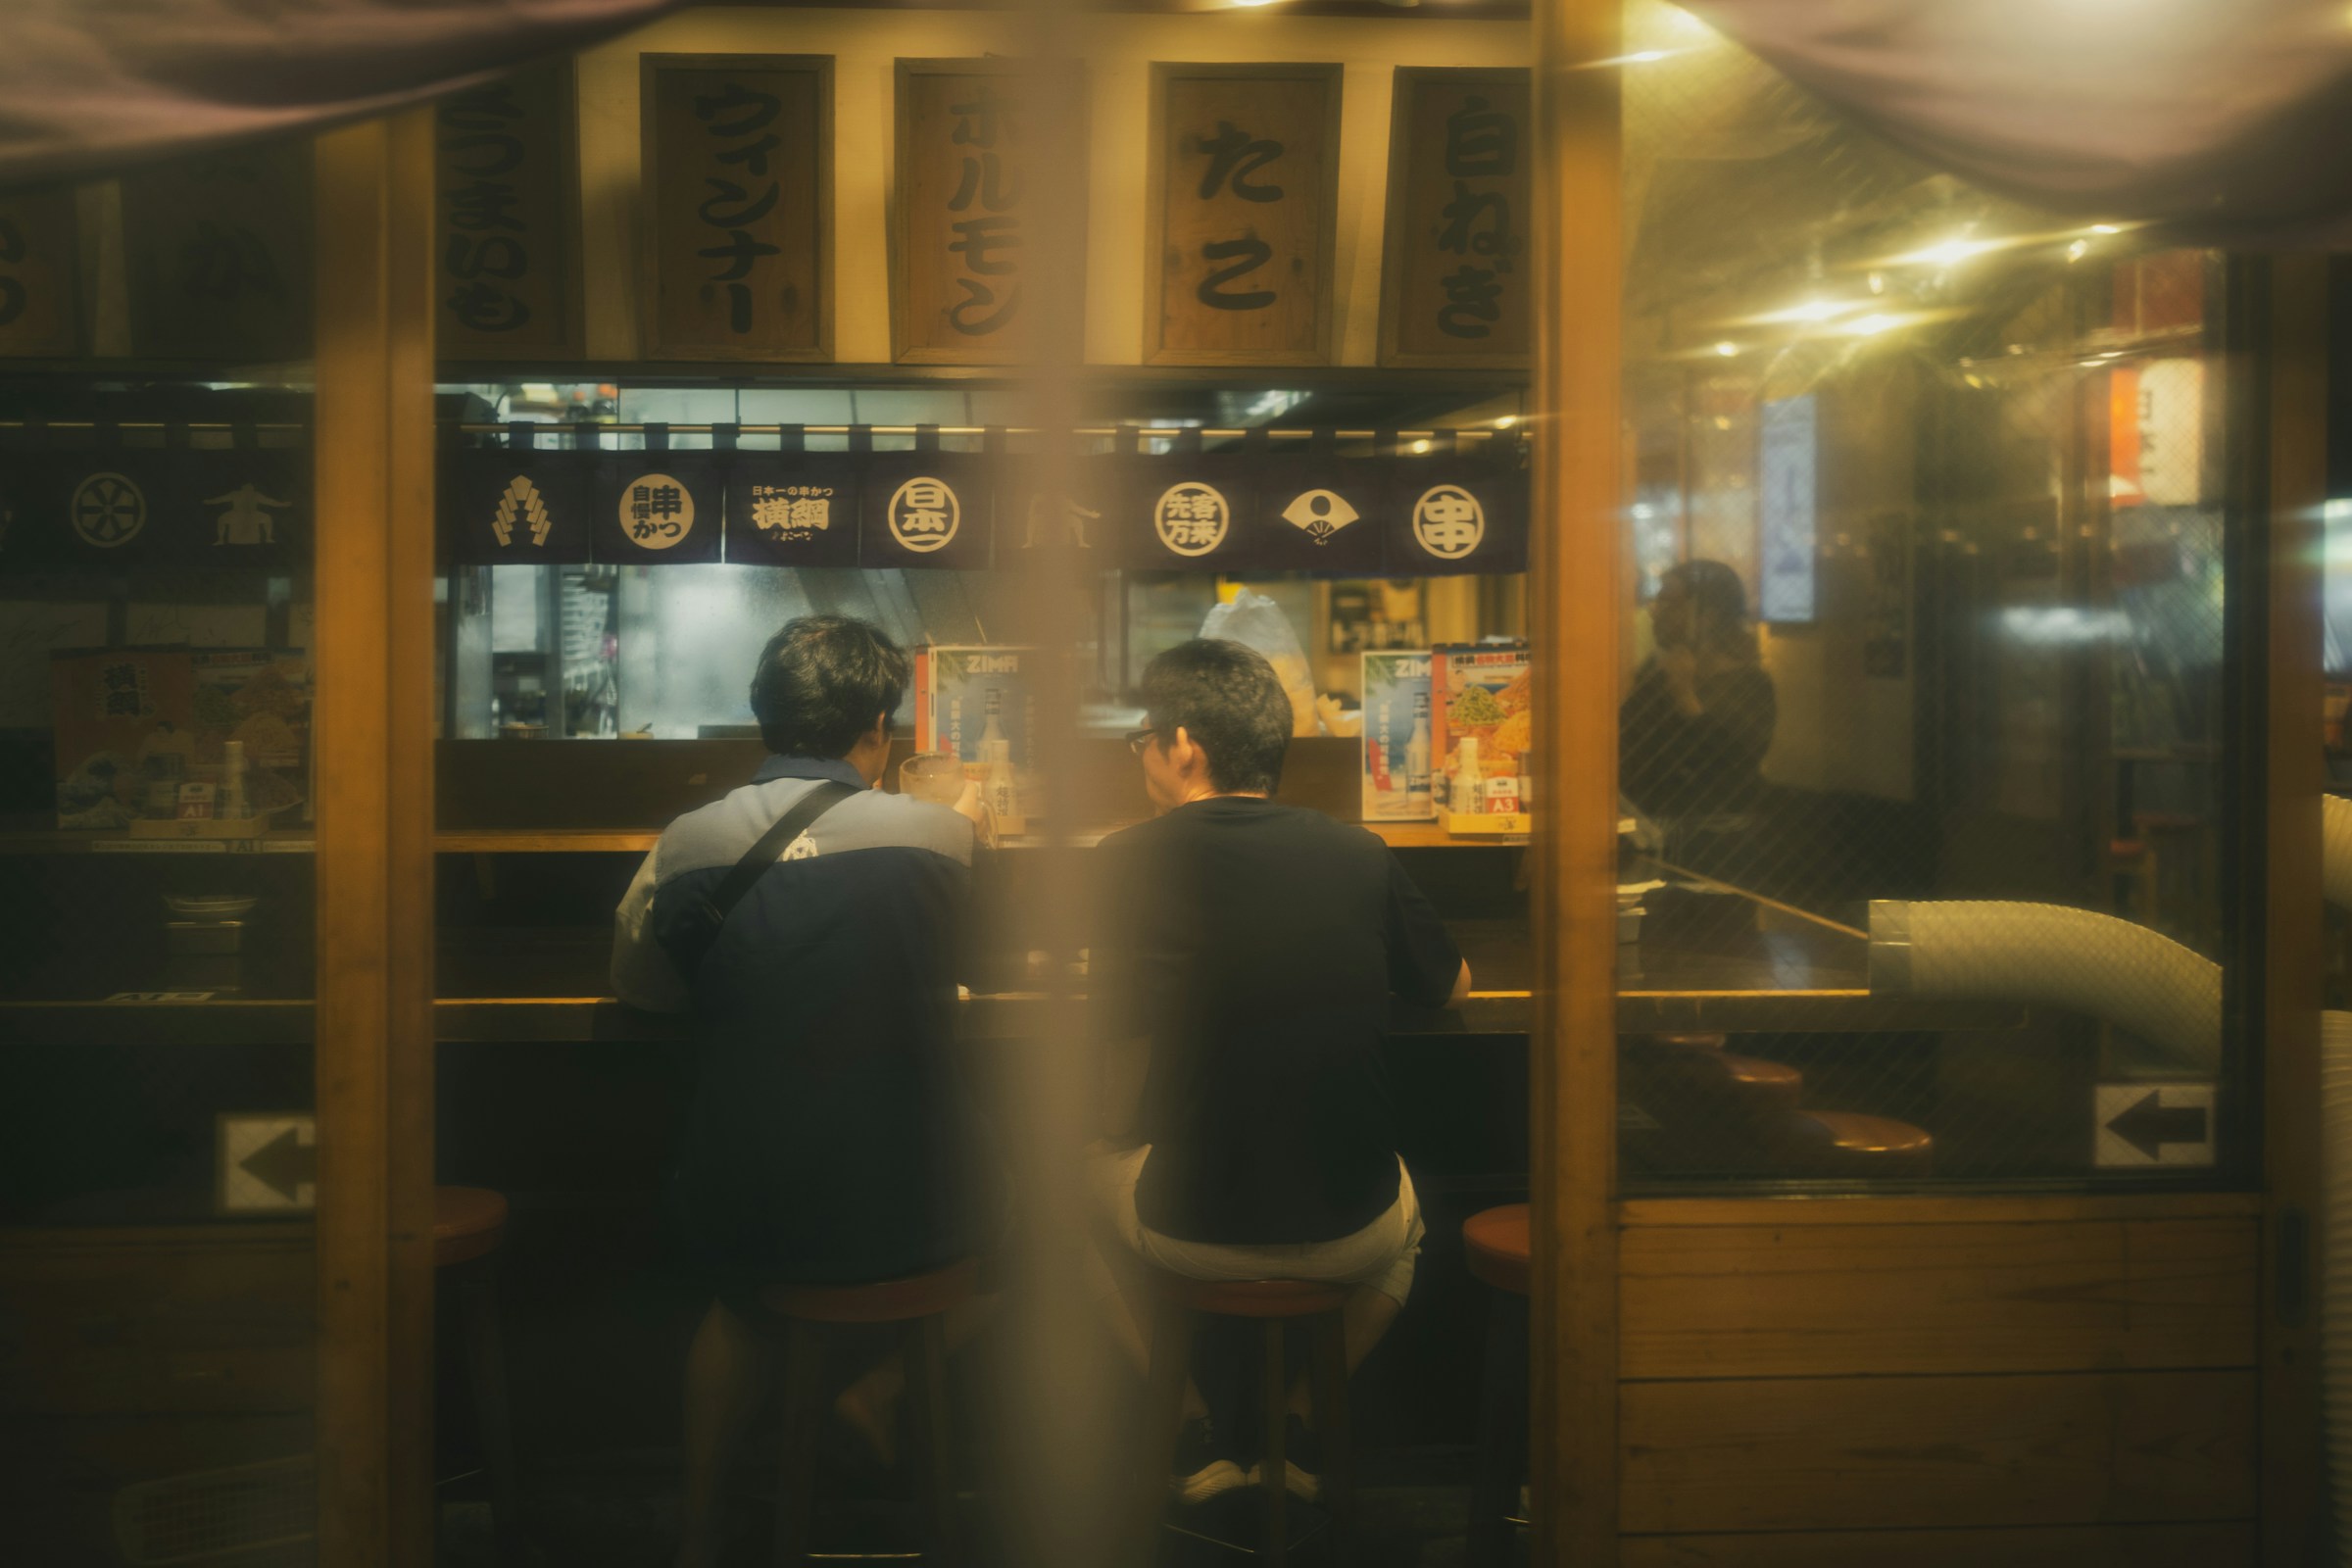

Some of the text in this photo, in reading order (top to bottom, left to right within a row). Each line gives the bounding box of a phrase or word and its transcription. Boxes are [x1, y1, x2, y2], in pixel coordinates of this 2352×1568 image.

[439, 85, 530, 332] さつまいも
[694, 82, 782, 334] ウィンナー
[947, 85, 1027, 336] ホルモン
[1193, 118, 1286, 312] たこ
[1436, 85, 1520, 330] 白ねぎ
[752, 485, 834, 497] 日本一の串かつ
[752, 497, 831, 531] 横綱
[901, 485, 947, 544] 日本一
[1423, 495, 1476, 553] 串
[966, 655, 1018, 674] ZIMA
[1493, 798, 1514, 812] A3
